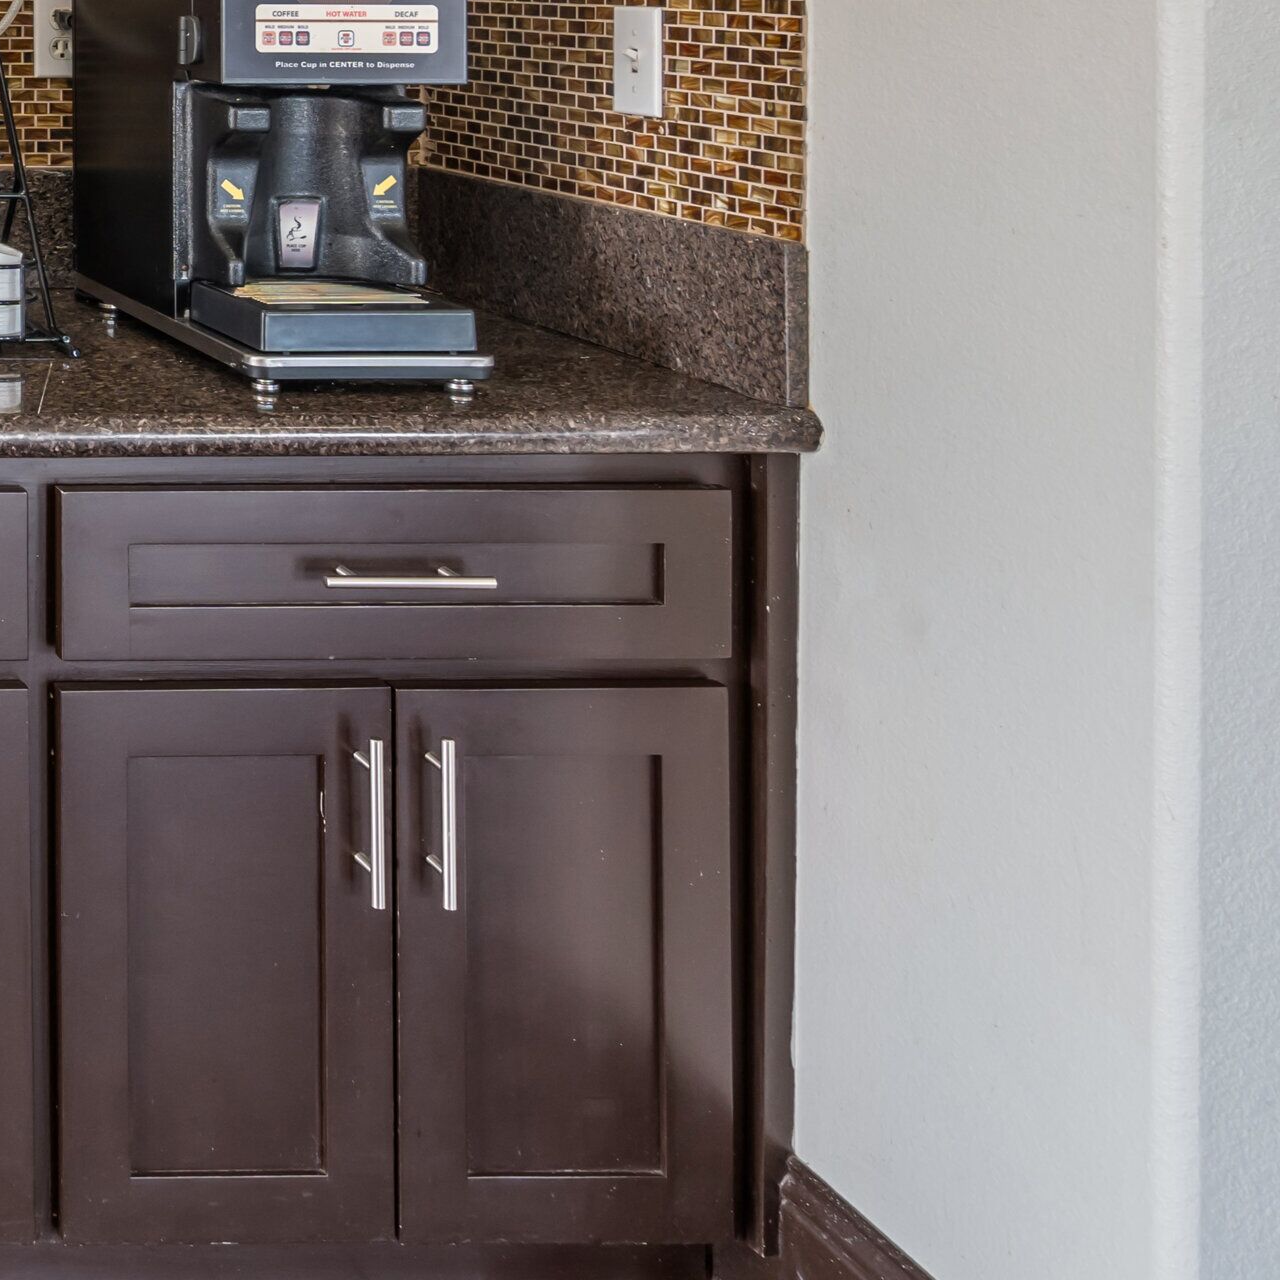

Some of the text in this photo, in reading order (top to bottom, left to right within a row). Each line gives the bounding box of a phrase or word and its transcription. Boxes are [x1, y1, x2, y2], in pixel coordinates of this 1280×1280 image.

[272, 10, 299, 18] COFFEE
[301, 61, 317, 70] Cup
[377, 61, 415, 70] Dispense
